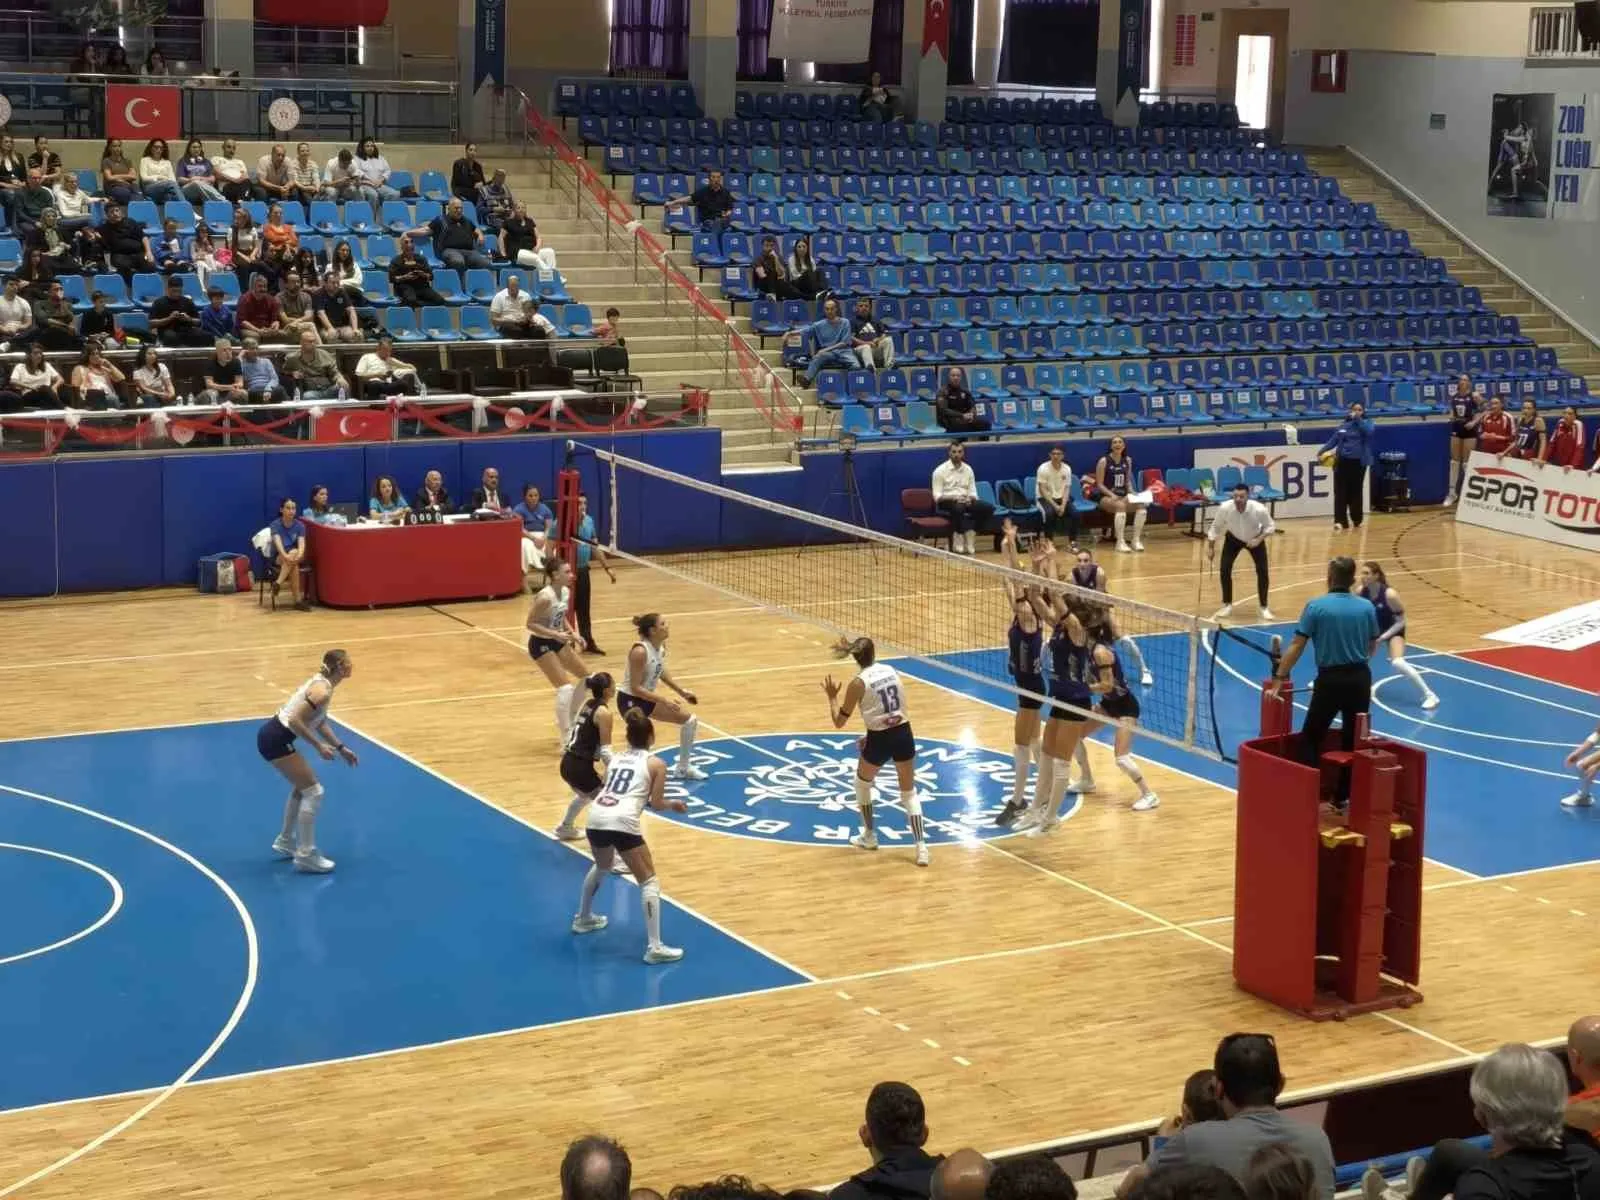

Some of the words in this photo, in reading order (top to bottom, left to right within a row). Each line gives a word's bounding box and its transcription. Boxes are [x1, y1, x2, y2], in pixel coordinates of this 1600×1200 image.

[1465, 475, 1539, 512] SPOR
[876, 684, 901, 713] 13
[606, 767, 635, 795] 18
